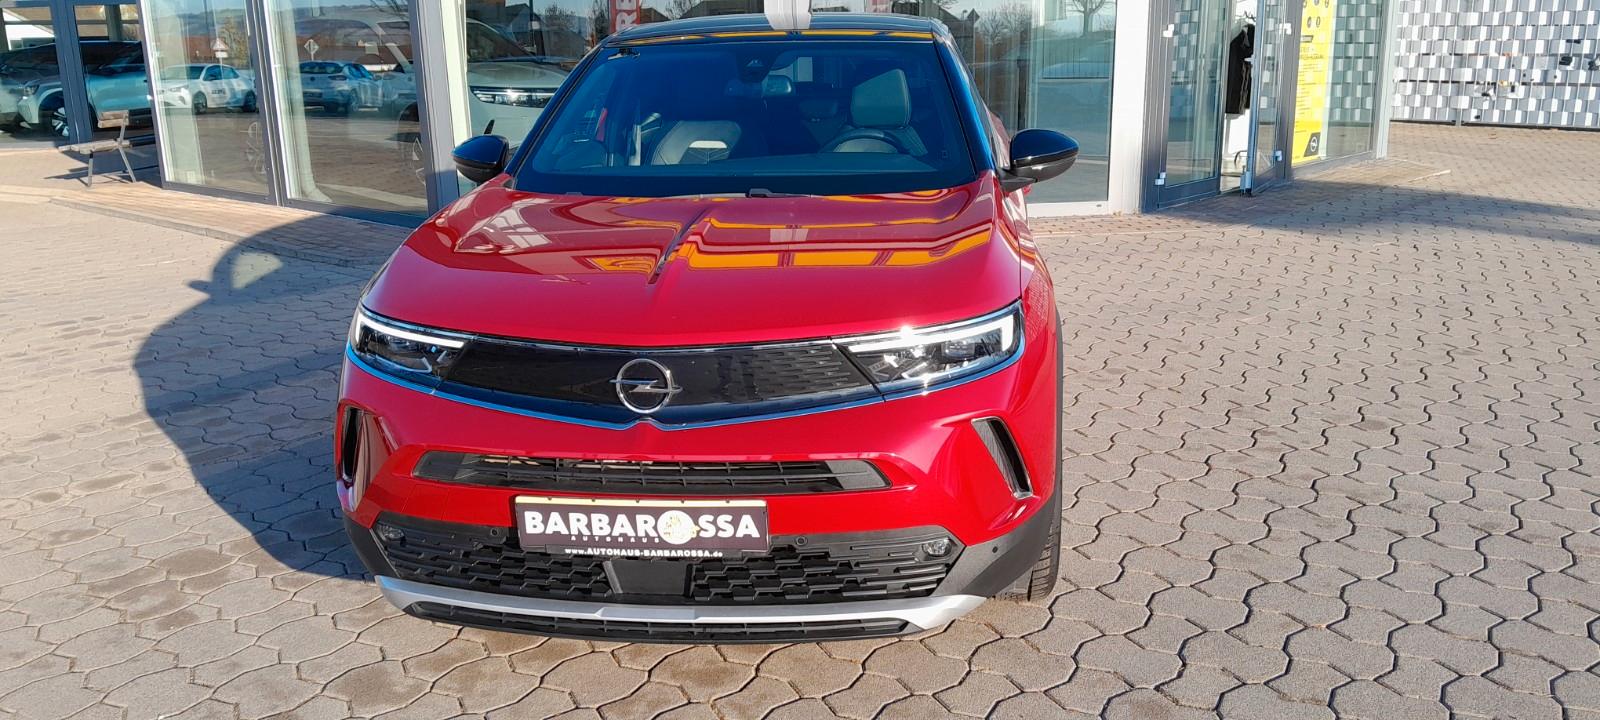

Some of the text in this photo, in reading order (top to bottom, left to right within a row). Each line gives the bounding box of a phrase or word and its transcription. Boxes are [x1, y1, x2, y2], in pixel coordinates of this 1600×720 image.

[524, 510, 760, 544] BARBAROSSA
[571, 535, 660, 543] AUTOHAUS
[565, 547, 723, 557] www.AUTOHAUS-BARBAROSSA.de
